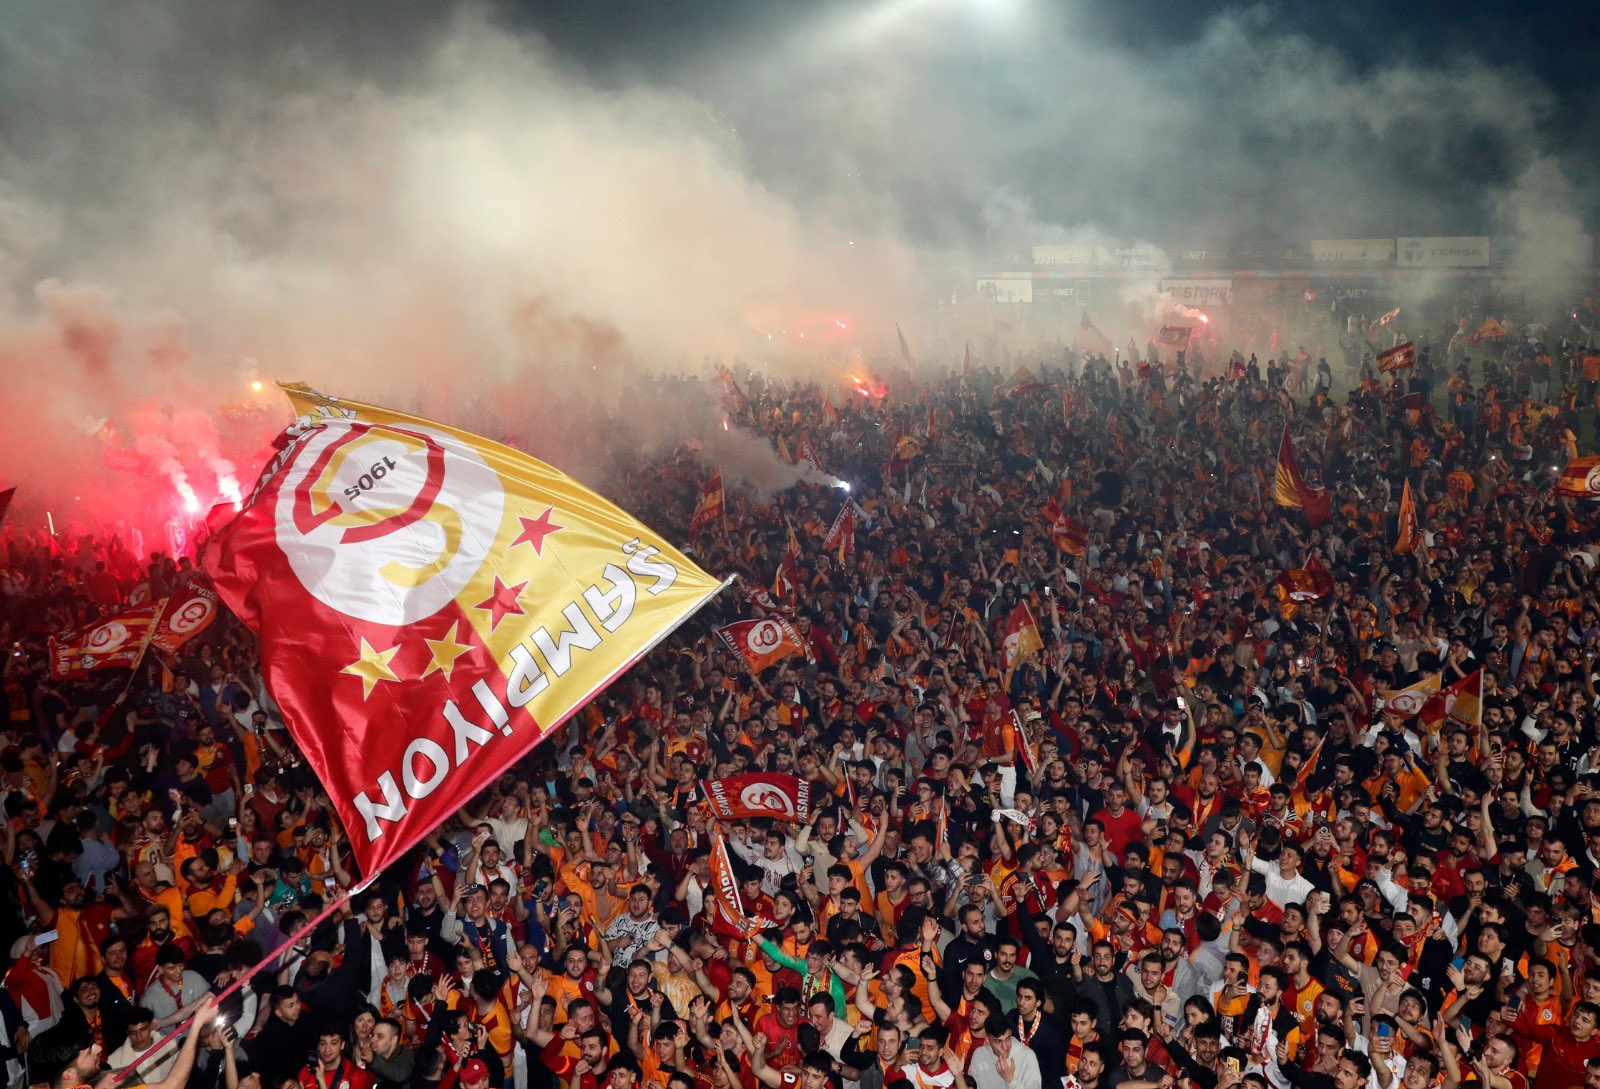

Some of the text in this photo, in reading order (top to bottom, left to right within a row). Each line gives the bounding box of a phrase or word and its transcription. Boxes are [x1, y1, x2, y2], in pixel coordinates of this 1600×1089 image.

[1431, 249, 1481, 257] TEMSA
[343, 456, 396, 501] 1905
[1449, 477, 1465, 490] 99
[352, 538, 680, 844] ŞAMPİYON
